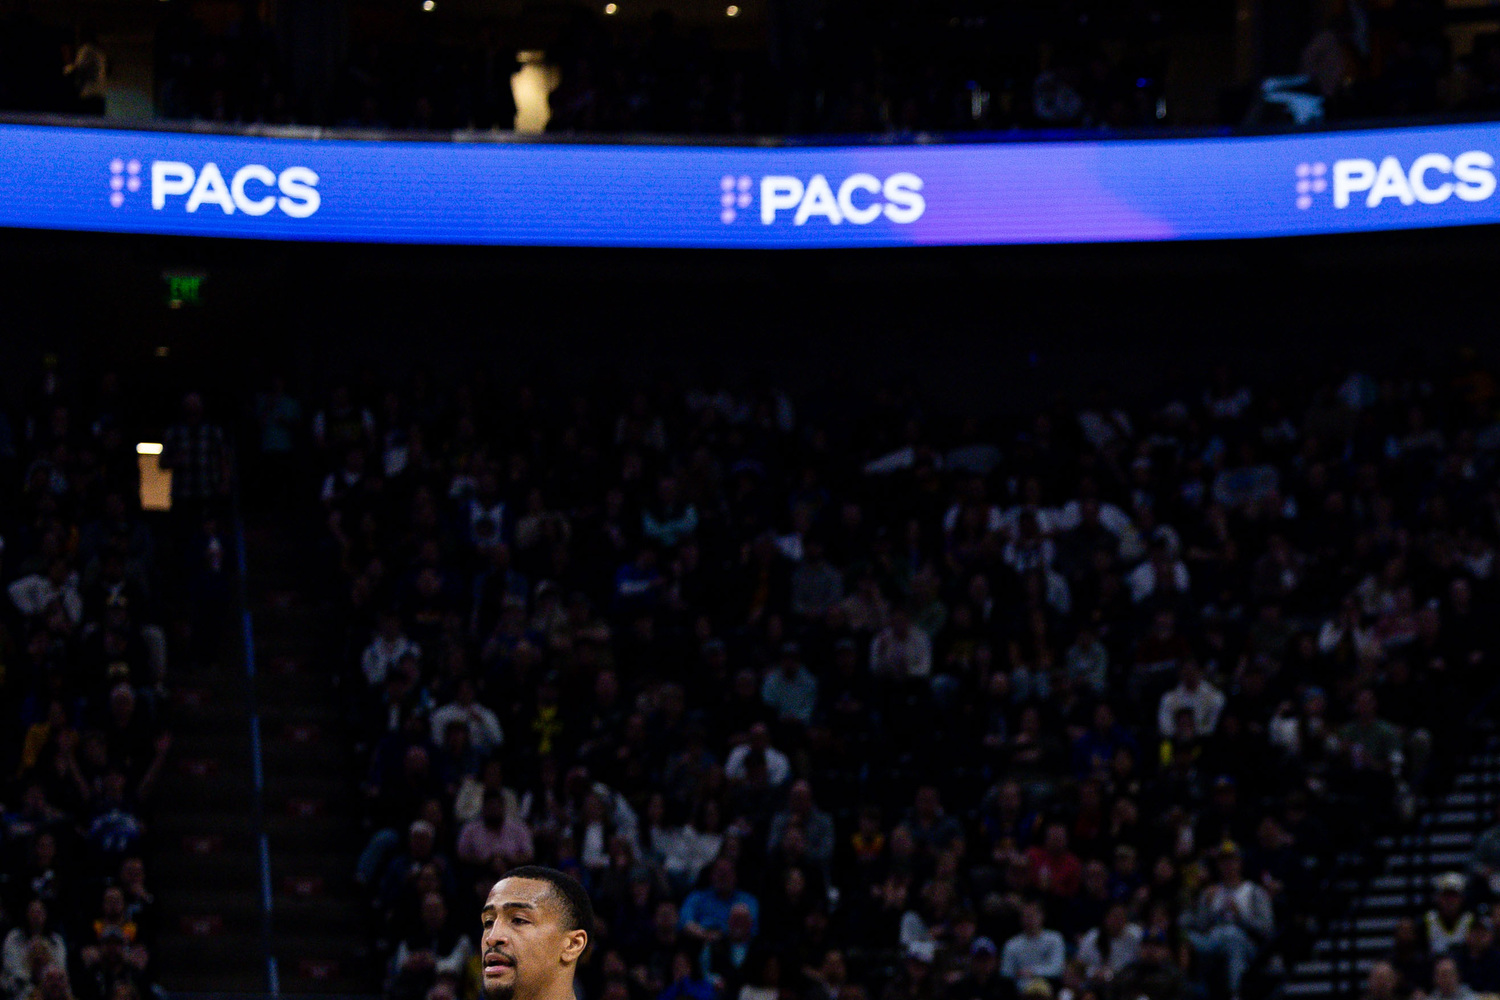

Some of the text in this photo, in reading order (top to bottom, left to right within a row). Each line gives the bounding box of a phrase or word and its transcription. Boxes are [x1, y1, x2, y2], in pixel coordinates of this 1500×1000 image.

[151, 159, 321, 219] PACS
[759, 172, 926, 227] PACS
[1332, 149, 1497, 210] PACS
